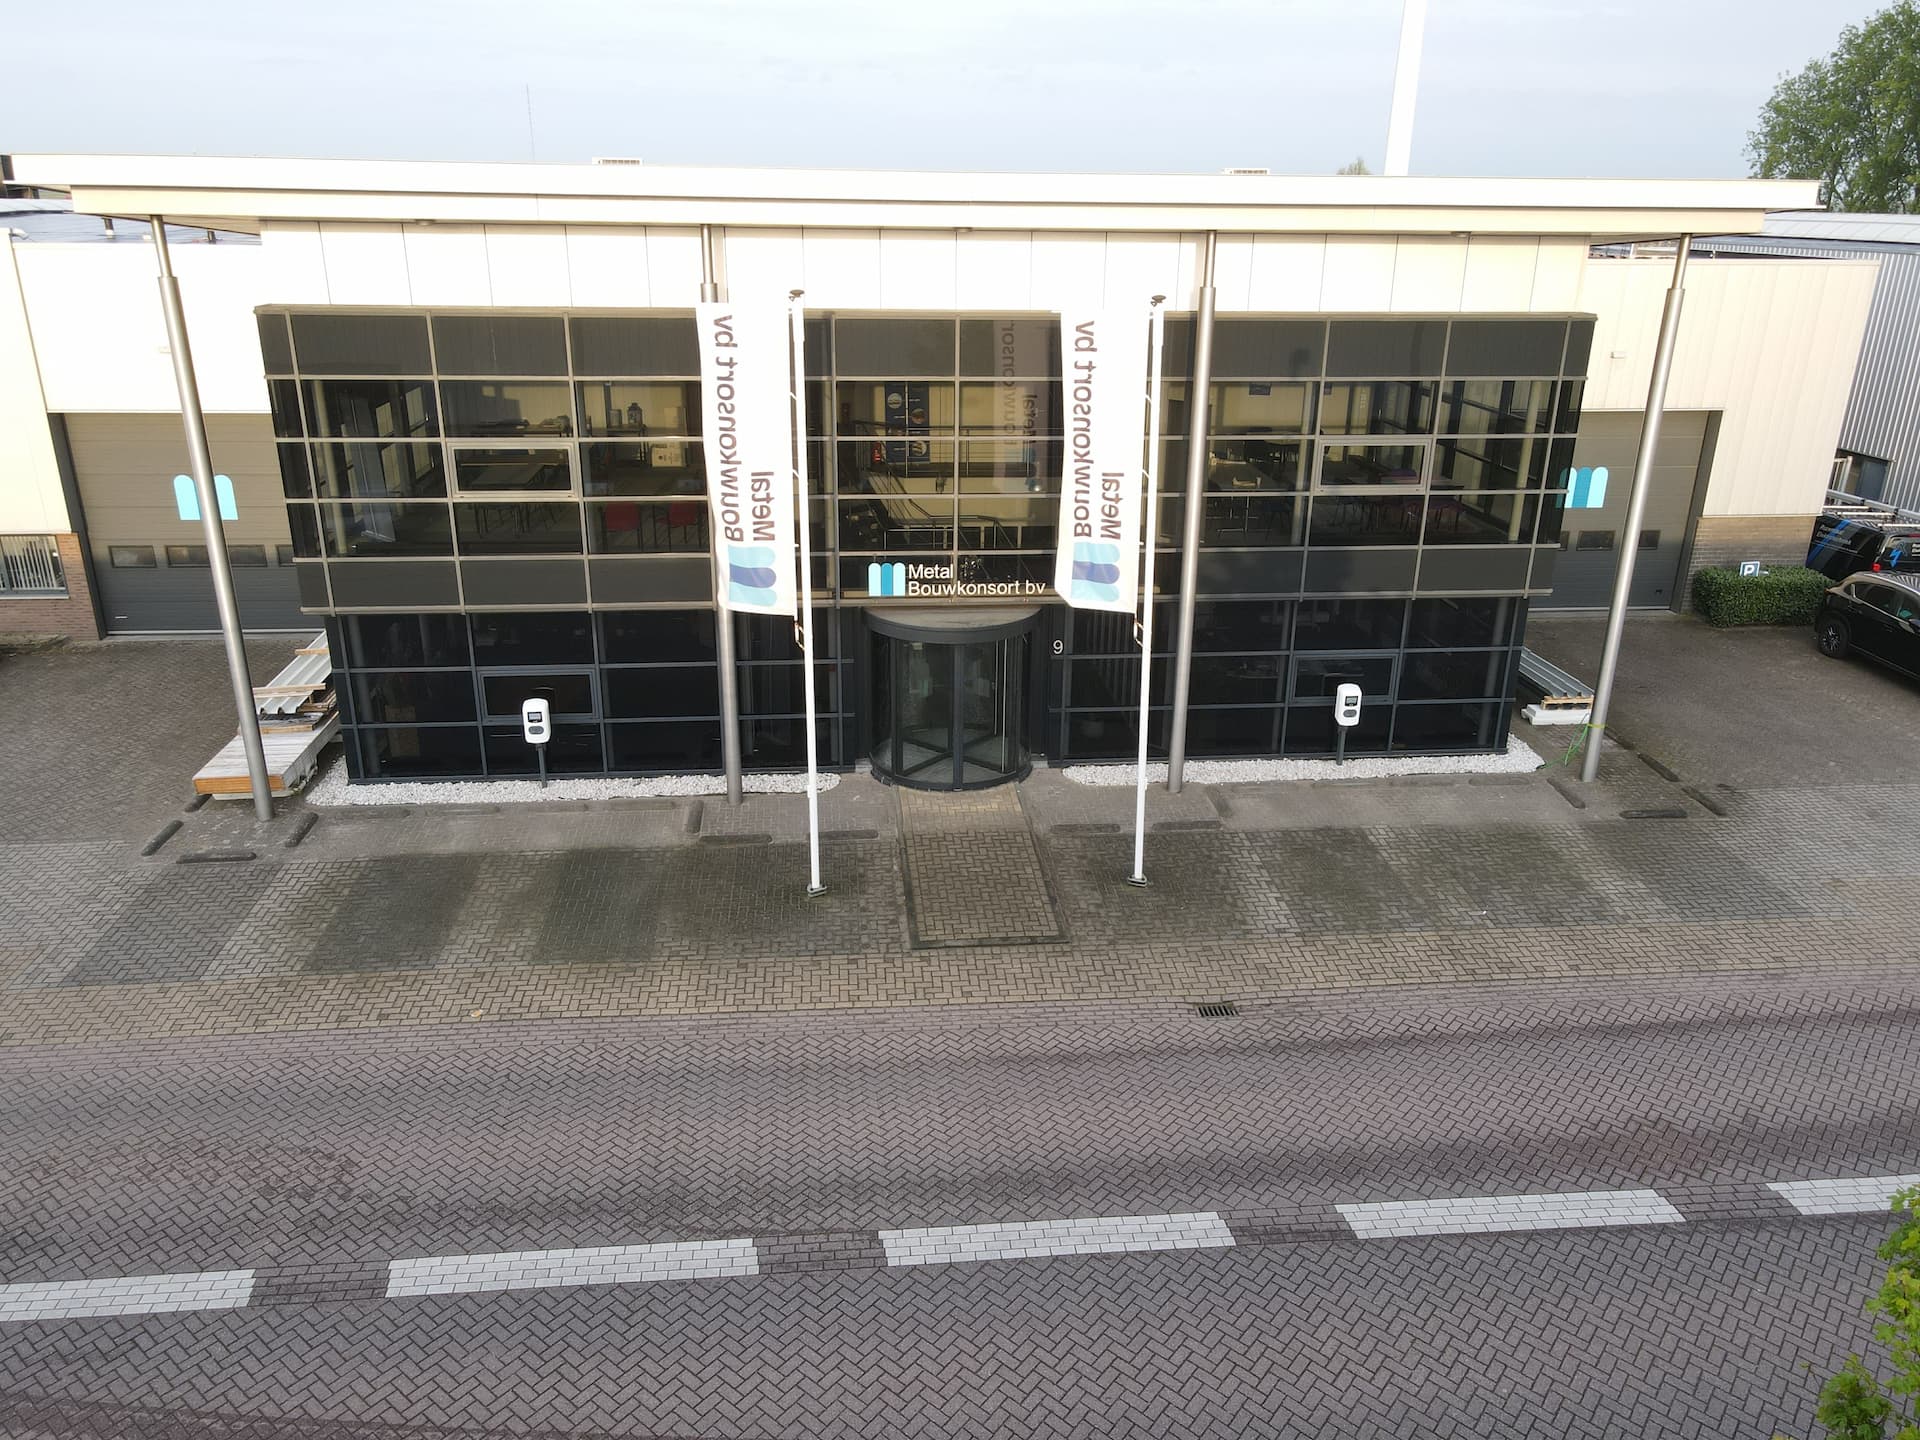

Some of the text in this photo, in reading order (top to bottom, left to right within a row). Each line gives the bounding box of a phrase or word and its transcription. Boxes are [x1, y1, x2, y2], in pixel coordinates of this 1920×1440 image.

[908, 563, 954, 579] Metal
[1743, 564, 1755, 576] P
[908, 579, 1046, 596] Bouwkonsort bv
[1052, 639, 1064, 655] 9
